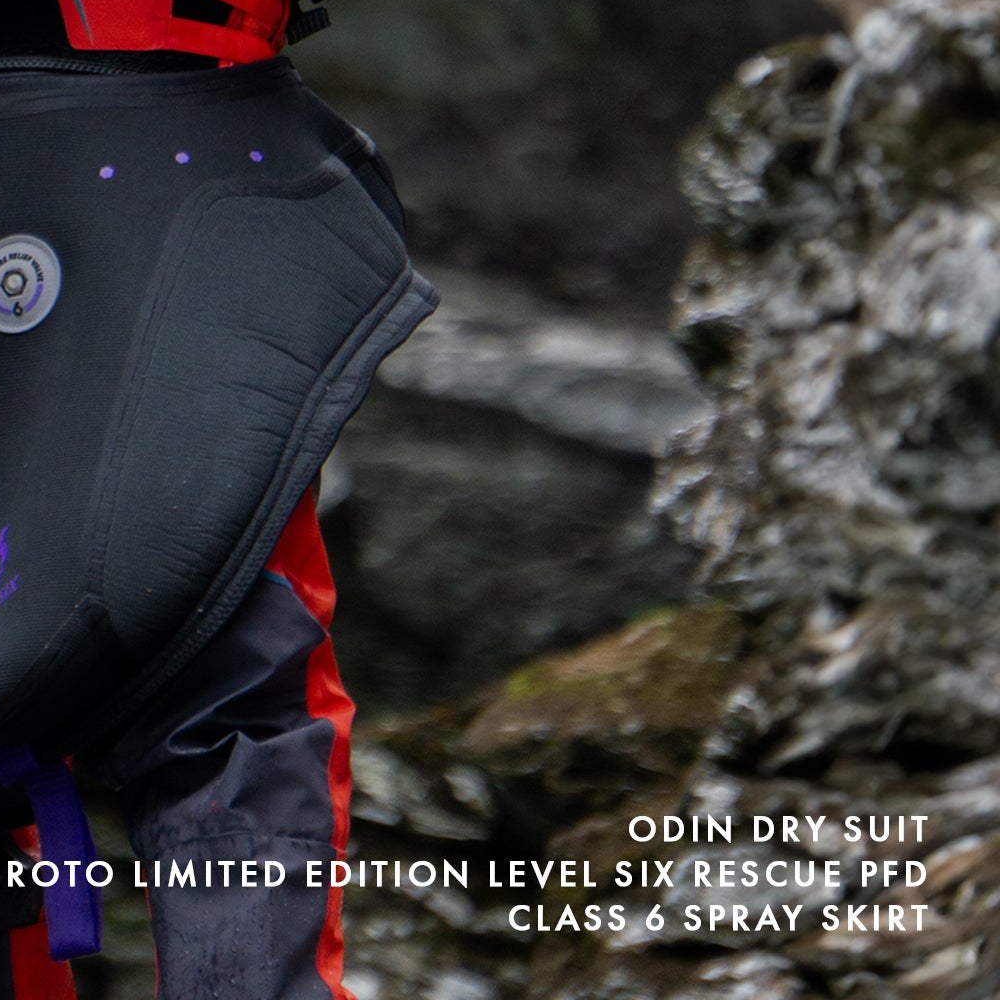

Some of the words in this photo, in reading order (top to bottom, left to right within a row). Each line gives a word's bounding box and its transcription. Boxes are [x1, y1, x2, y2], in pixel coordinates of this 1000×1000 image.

[8, 252, 33, 262] RELIEF
[30, 258, 45, 283] VALVE
[12, 301, 24, 317] 6
